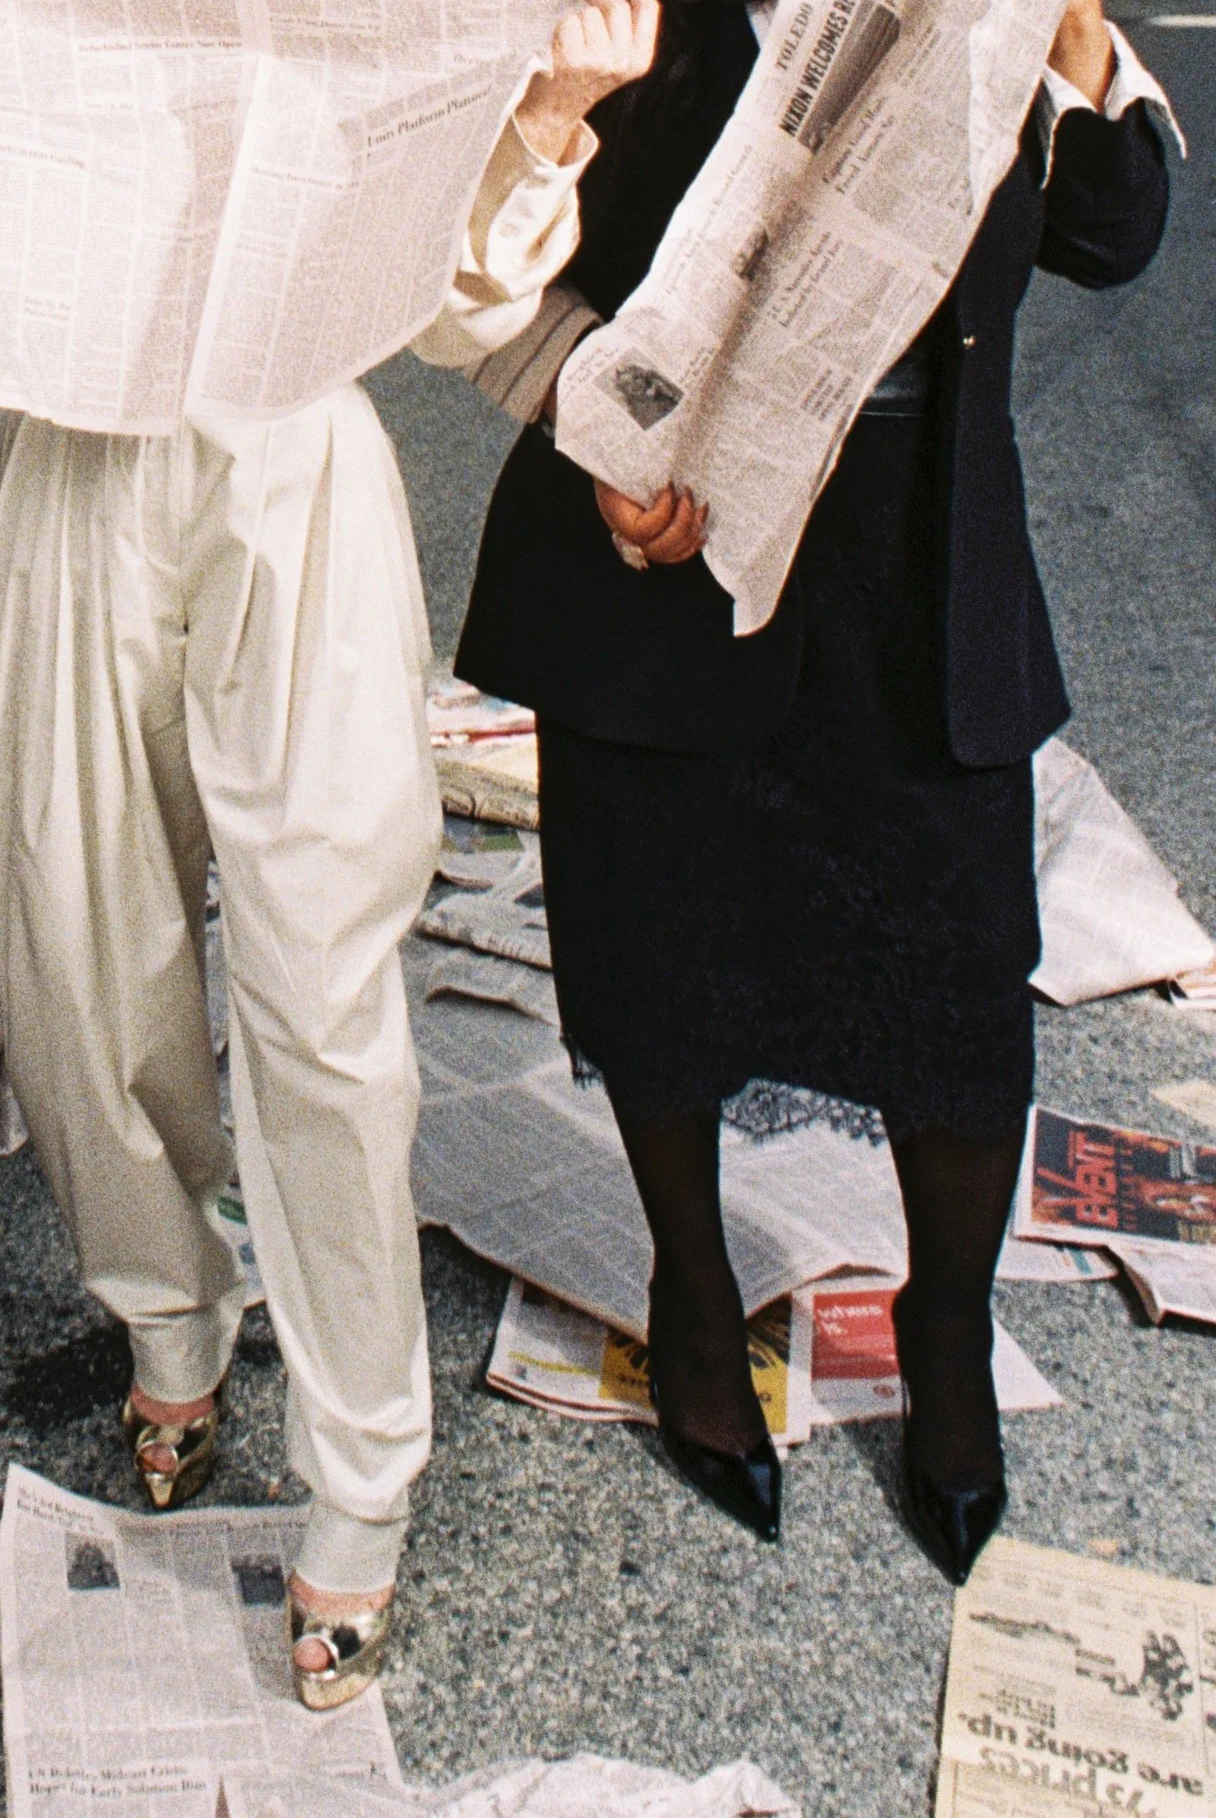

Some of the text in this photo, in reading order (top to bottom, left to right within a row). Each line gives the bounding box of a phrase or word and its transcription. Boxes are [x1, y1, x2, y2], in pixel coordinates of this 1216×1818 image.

[776, 2, 814, 72] TOLEDO
[780, 89, 814, 138] NIXON
[800, 11, 849, 93] WELCOMES
[1036, 1130, 1118, 1229] EVENT
[958, 1712, 1204, 1796] are going up.
[979, 1746, 1097, 1801] prices
